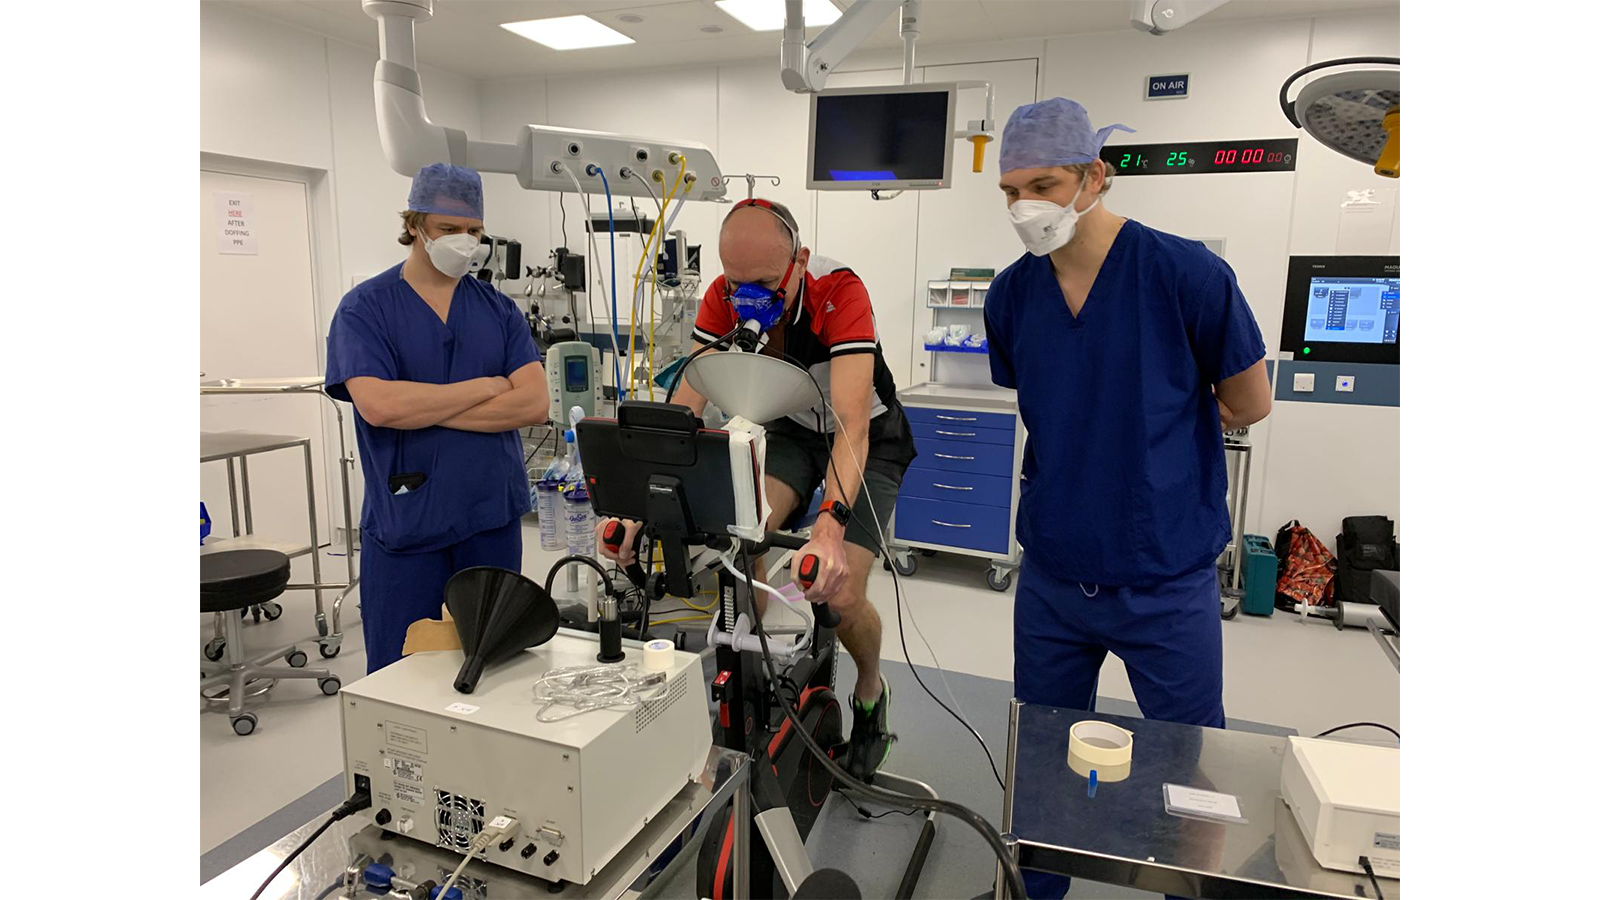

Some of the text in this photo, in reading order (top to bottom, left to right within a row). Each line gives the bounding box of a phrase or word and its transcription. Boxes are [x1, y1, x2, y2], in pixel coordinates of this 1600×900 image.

[1152, 80, 1185, 91] ON AIR
[1120, 154, 1141, 168] 21
[1166, 151, 1188, 166] 25
[224, 229, 250, 237] DOFFING
